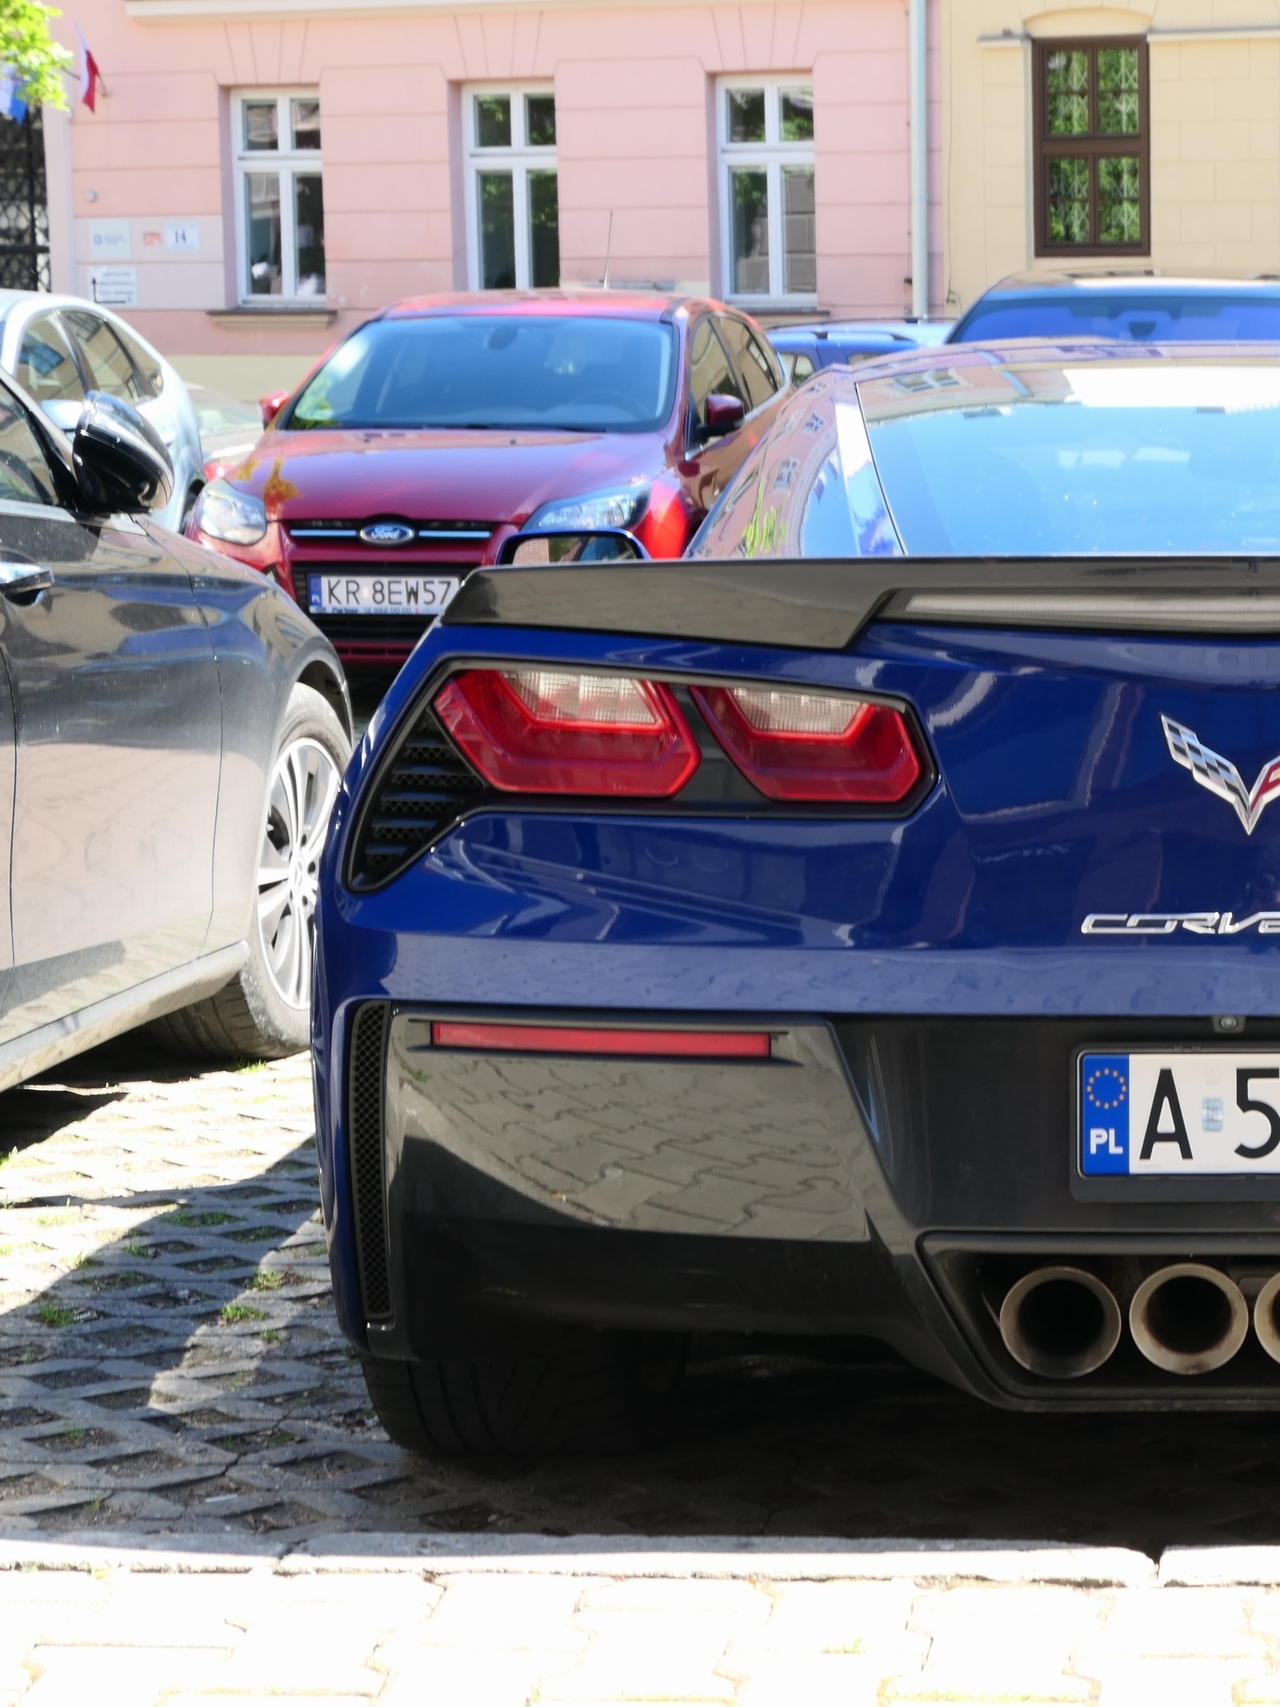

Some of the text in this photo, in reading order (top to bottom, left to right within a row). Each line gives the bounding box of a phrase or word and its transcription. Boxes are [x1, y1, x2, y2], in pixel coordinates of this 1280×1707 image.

[174, 229, 187, 243] 14
[371, 525, 400, 540] Ford
[311, 595, 321, 604] PL
[327, 580, 452, 605] KR 8EW57
[1138, 1067, 1194, 1161] A
[1089, 1127, 1124, 1155] PL
